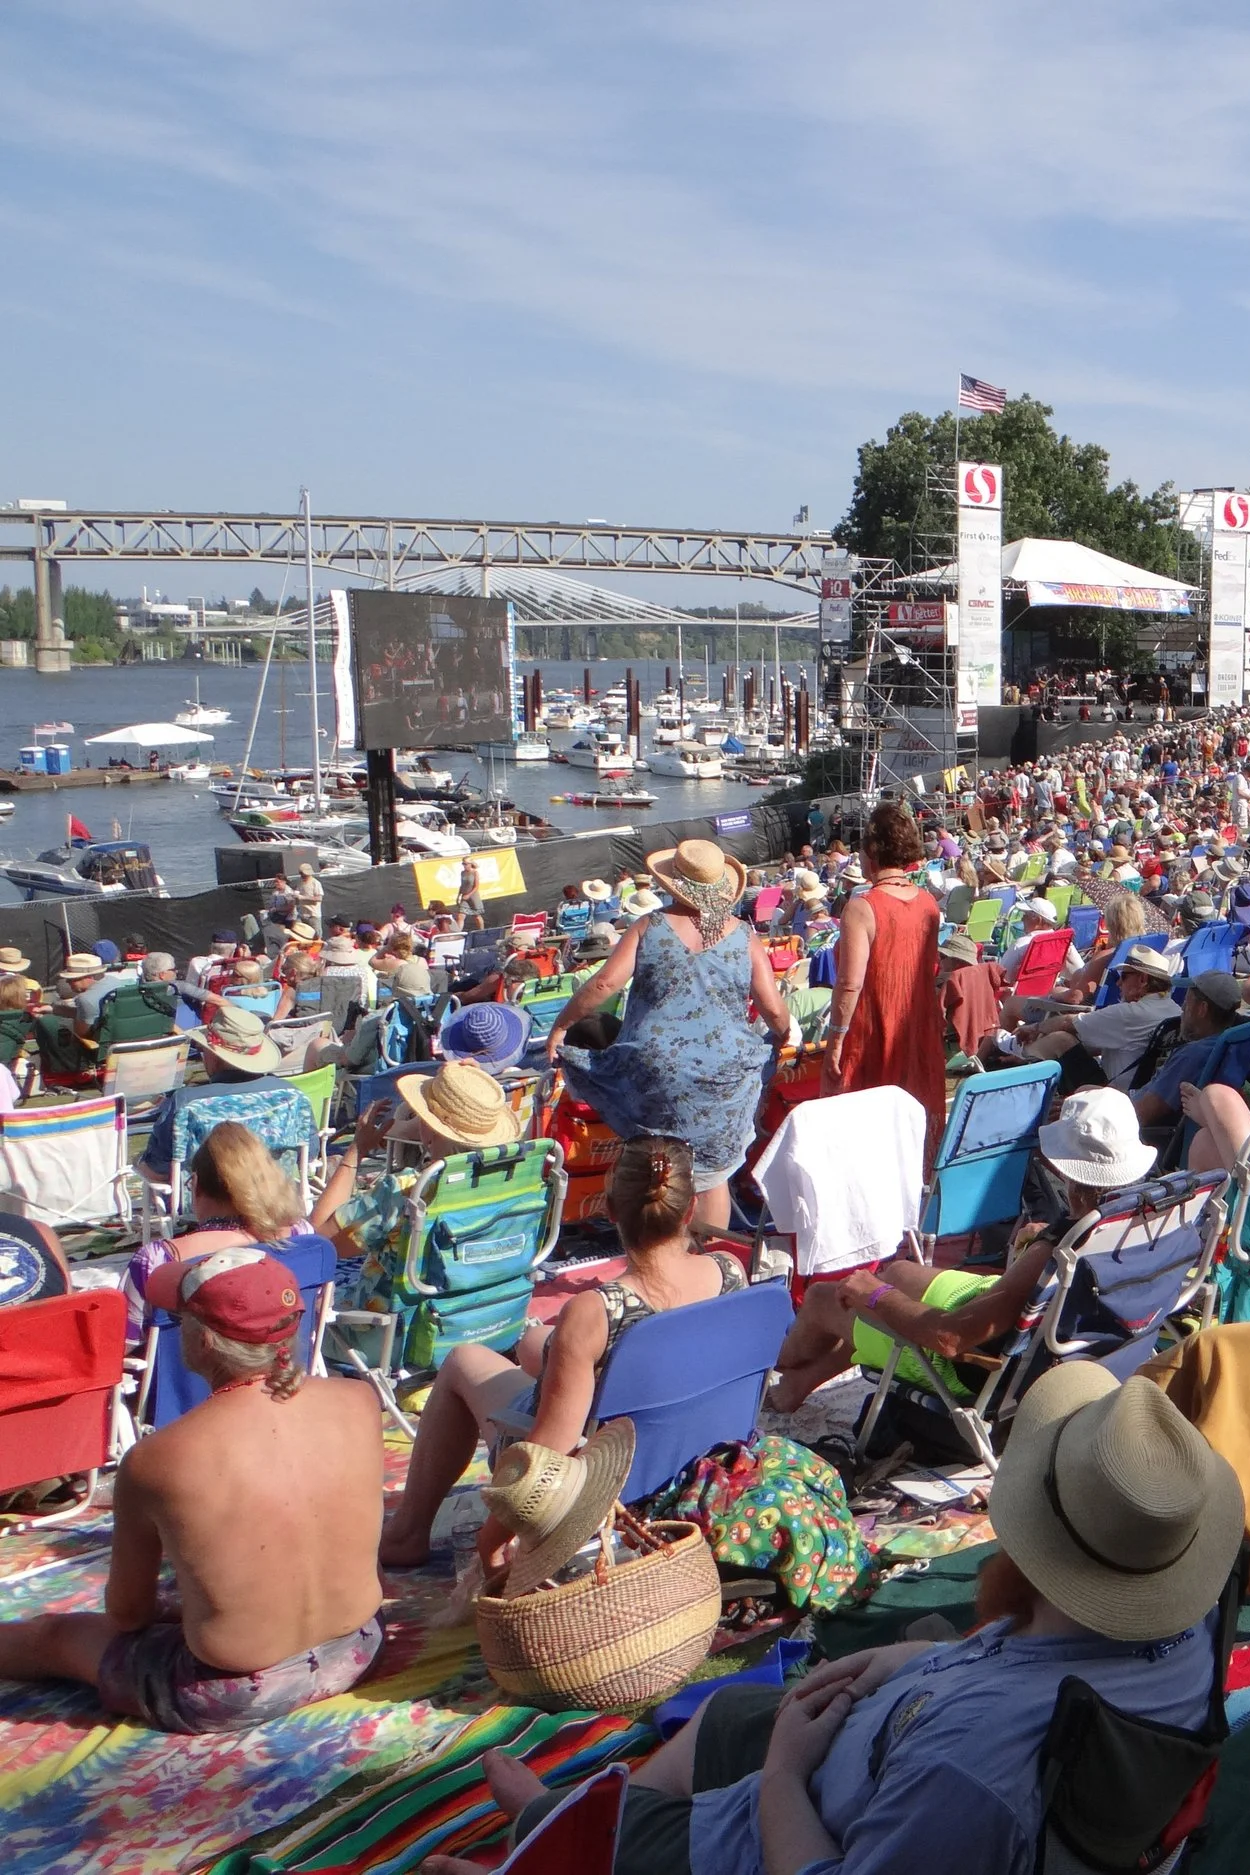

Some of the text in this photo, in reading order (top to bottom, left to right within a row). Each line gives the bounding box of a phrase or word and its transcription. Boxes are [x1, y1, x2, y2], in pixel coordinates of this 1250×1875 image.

[960, 531, 1000, 541] First Tech
[968, 600, 994, 608] GMC
[903, 754, 929, 768] LIGHT
